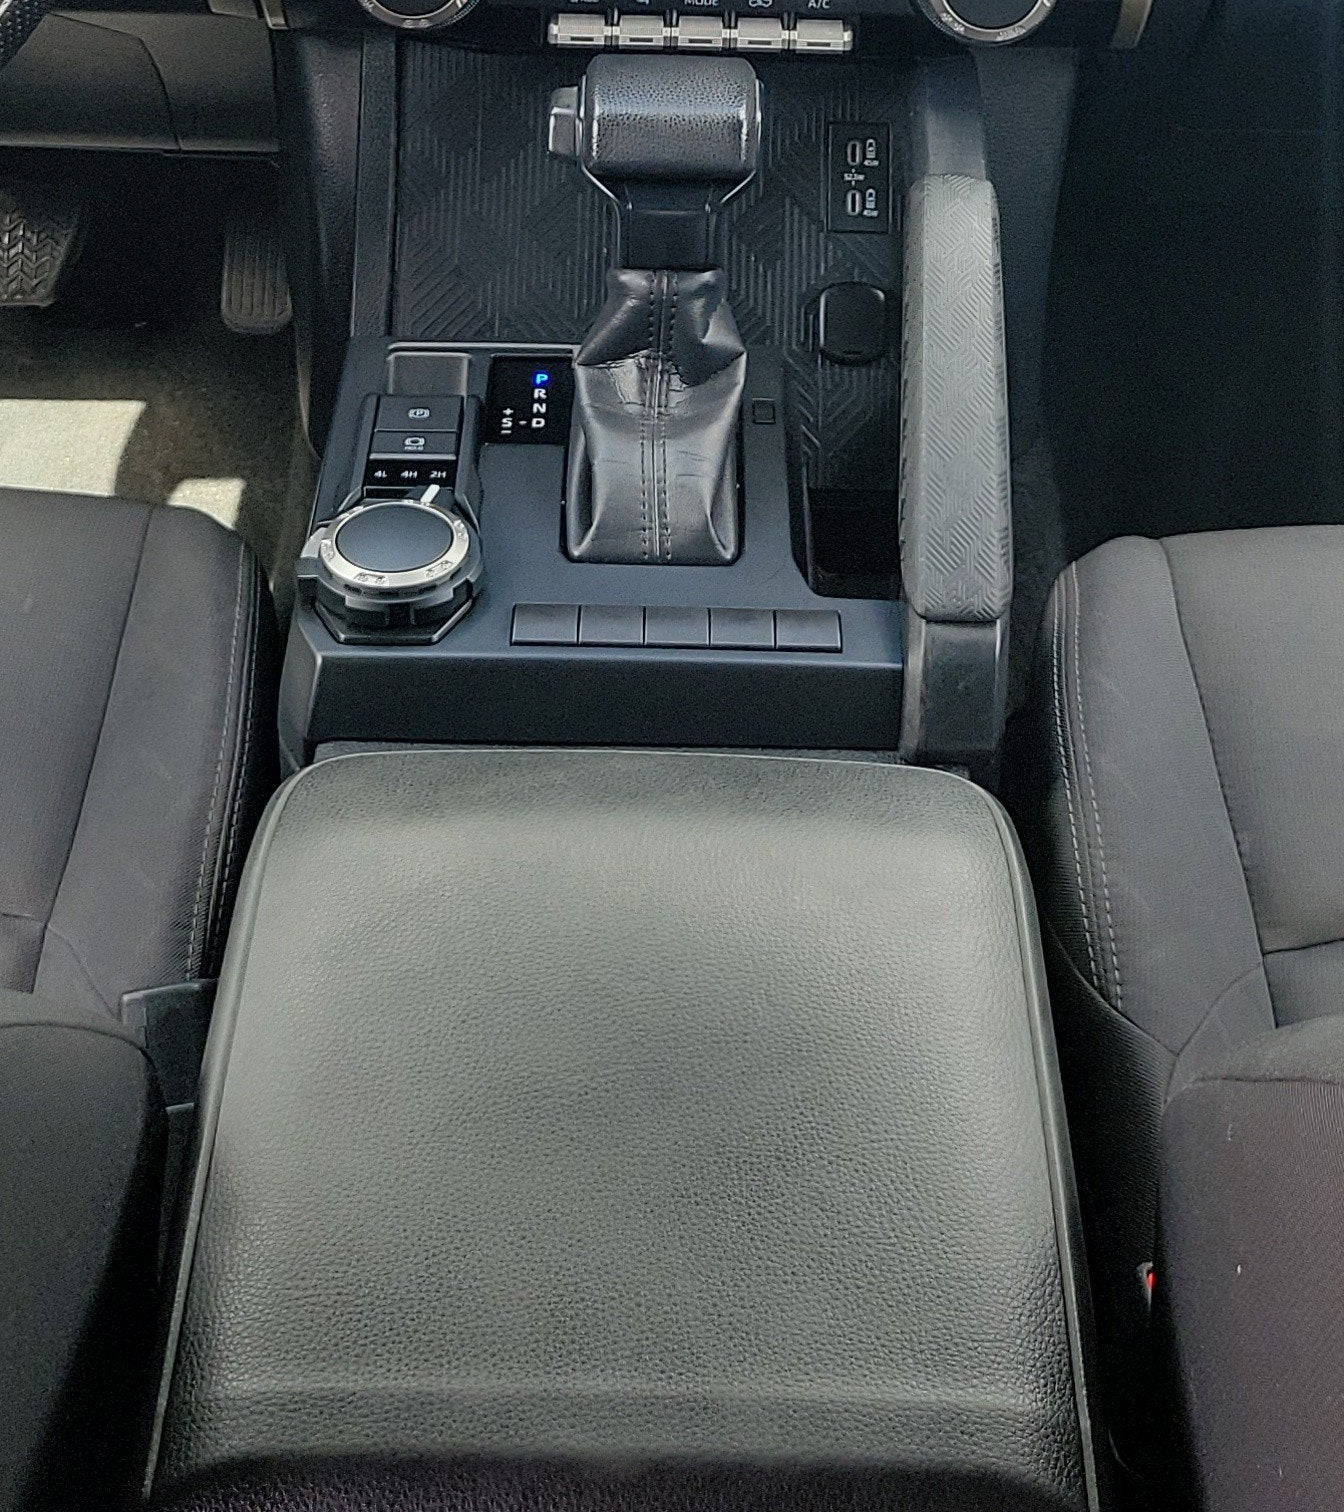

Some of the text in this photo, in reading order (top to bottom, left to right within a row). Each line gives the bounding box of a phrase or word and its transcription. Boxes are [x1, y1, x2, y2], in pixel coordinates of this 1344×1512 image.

[535, 373, 549, 385] P
[533, 388, 548, 399] R
[532, 402, 547, 414] N
[501, 417, 513, 429] S
[531, 417, 546, 429] D
[374, 470, 388, 478] 4L
[400, 470, 418, 479] 4H
[429, 470, 447, 479] 2H
